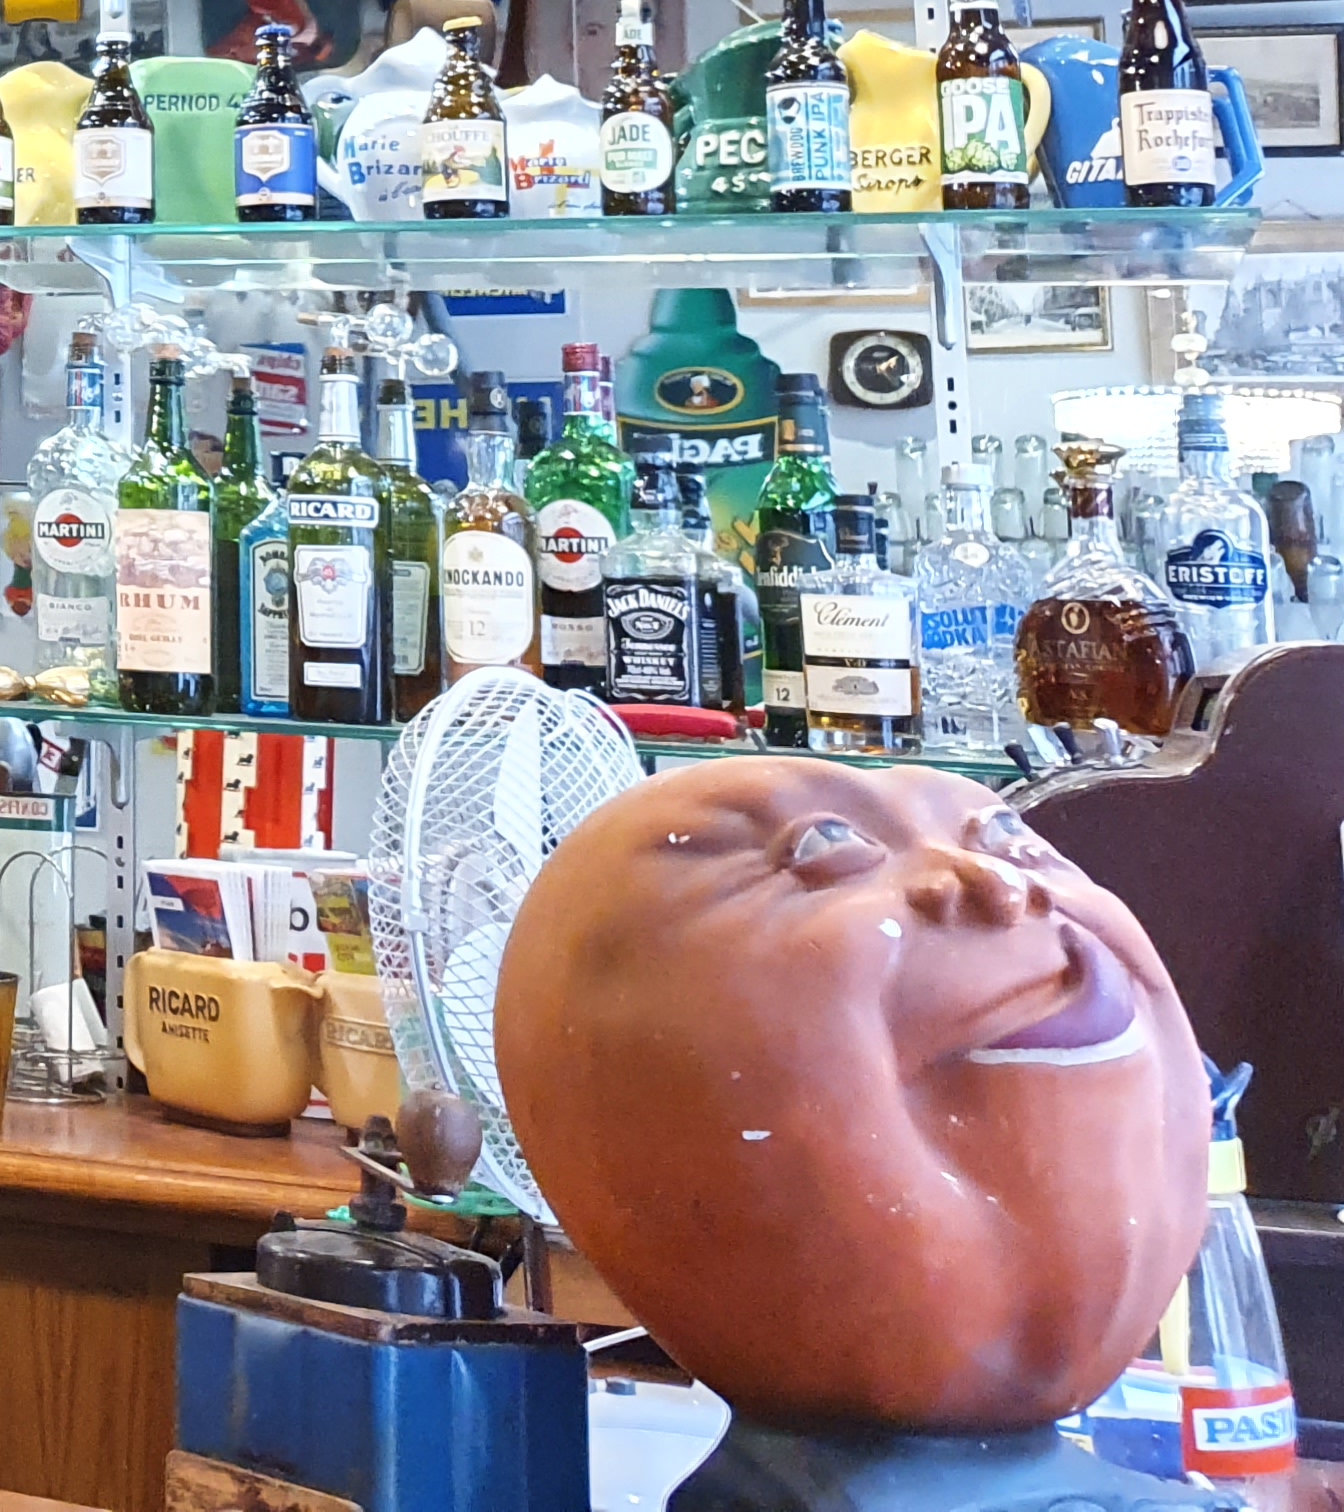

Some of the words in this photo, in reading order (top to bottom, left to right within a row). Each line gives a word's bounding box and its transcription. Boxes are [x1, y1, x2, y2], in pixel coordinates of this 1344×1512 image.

[941, 79, 1009, 95] GOOSE
[144, 92, 220, 113] PERNOD
[813, 91, 828, 122] IPA
[609, 124, 651, 144] JADE
[944, 92, 1021, 159] IPA
[344, 136, 400, 155] Marie
[813, 129, 828, 182] PUNK
[850, 145, 932, 169] BERGER
[348, 160, 422, 187] Brizar
[291, 501, 371, 519] RICARD
[38, 522, 104, 538] MARTINI
[49, 602, 92, 611] BIANCO
[120, 592, 201, 610] RHUM
[607, 592, 638, 618] JACK
[639, 589, 690, 621] DANIEL'S
[814, 599, 889, 629] Clément
[775, 687, 790, 702] 12
[148, 986, 221, 1022] RICARD
[161, 1023, 211, 1044] ANISETTE
